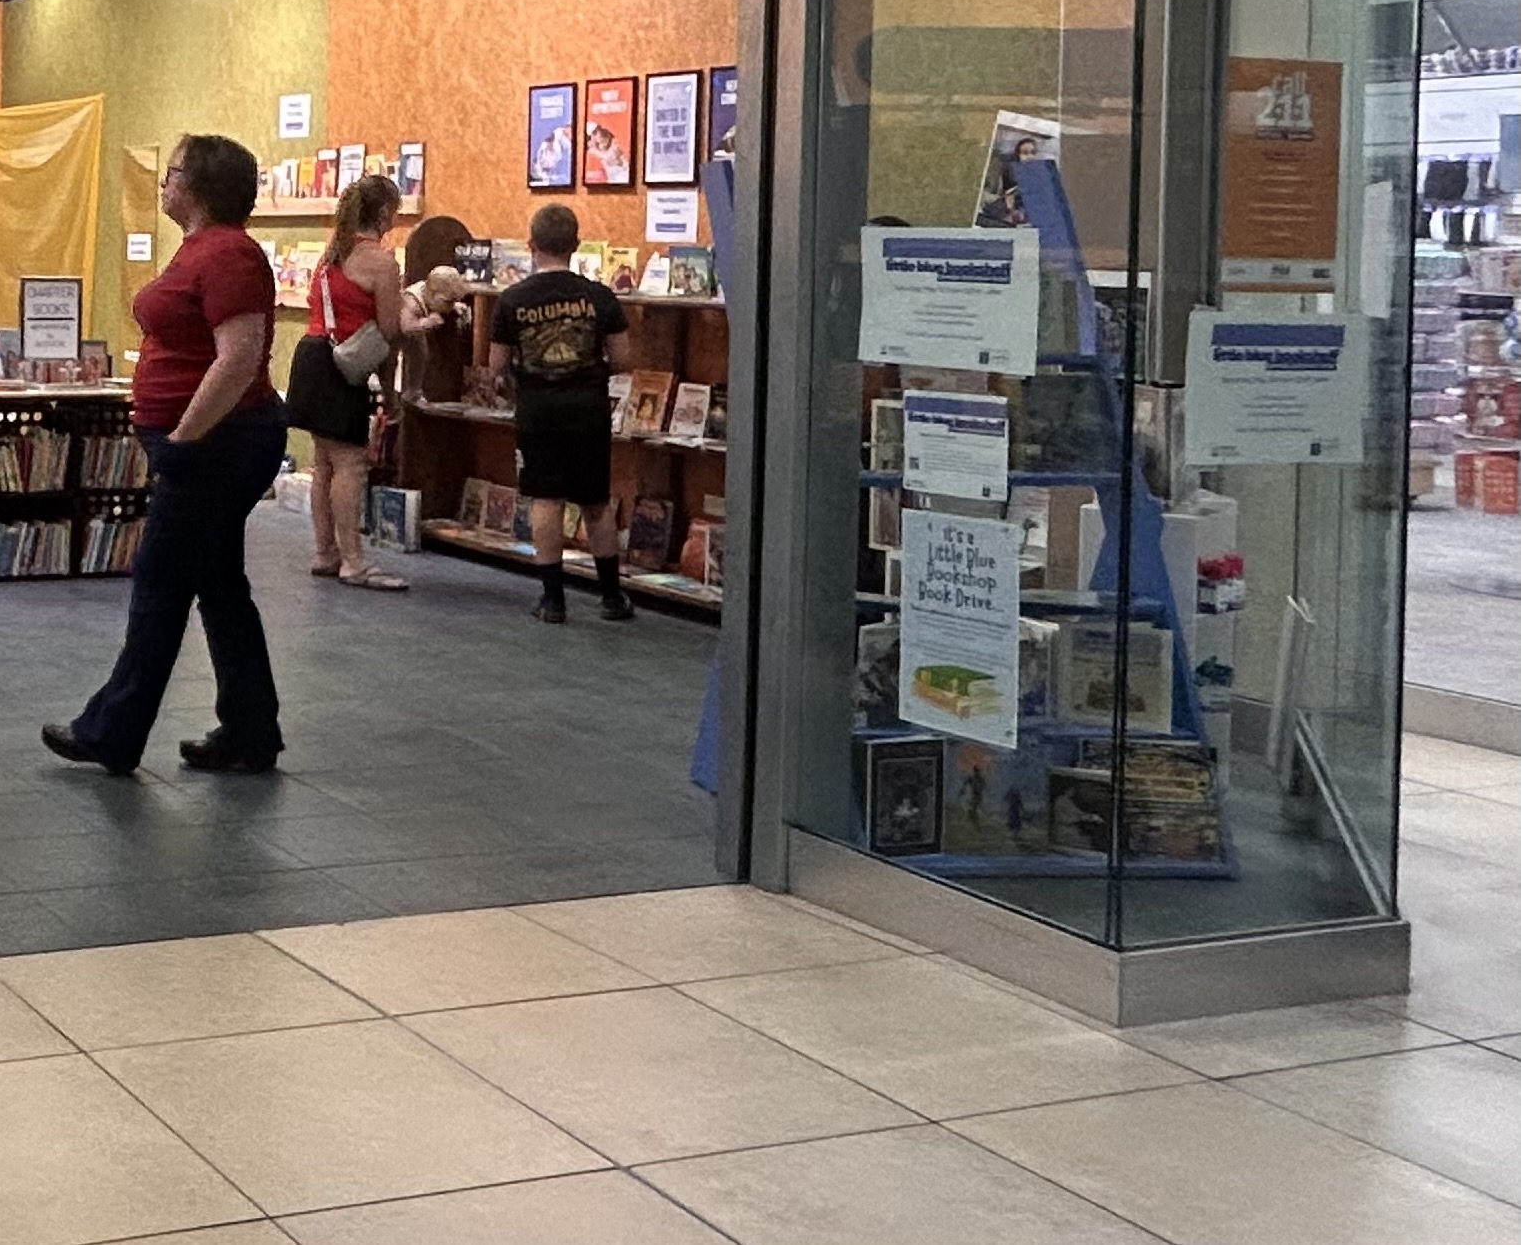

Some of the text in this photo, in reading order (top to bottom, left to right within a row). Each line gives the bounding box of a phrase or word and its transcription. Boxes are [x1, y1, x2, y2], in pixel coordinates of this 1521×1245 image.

[1255, 87, 1313, 128] 211
[516, 297, 596, 324] COLUMBIA
[927, 541, 997, 570] Little Blue
[926, 561, 998, 594] Bookshop
[918, 580, 952, 605] Book
